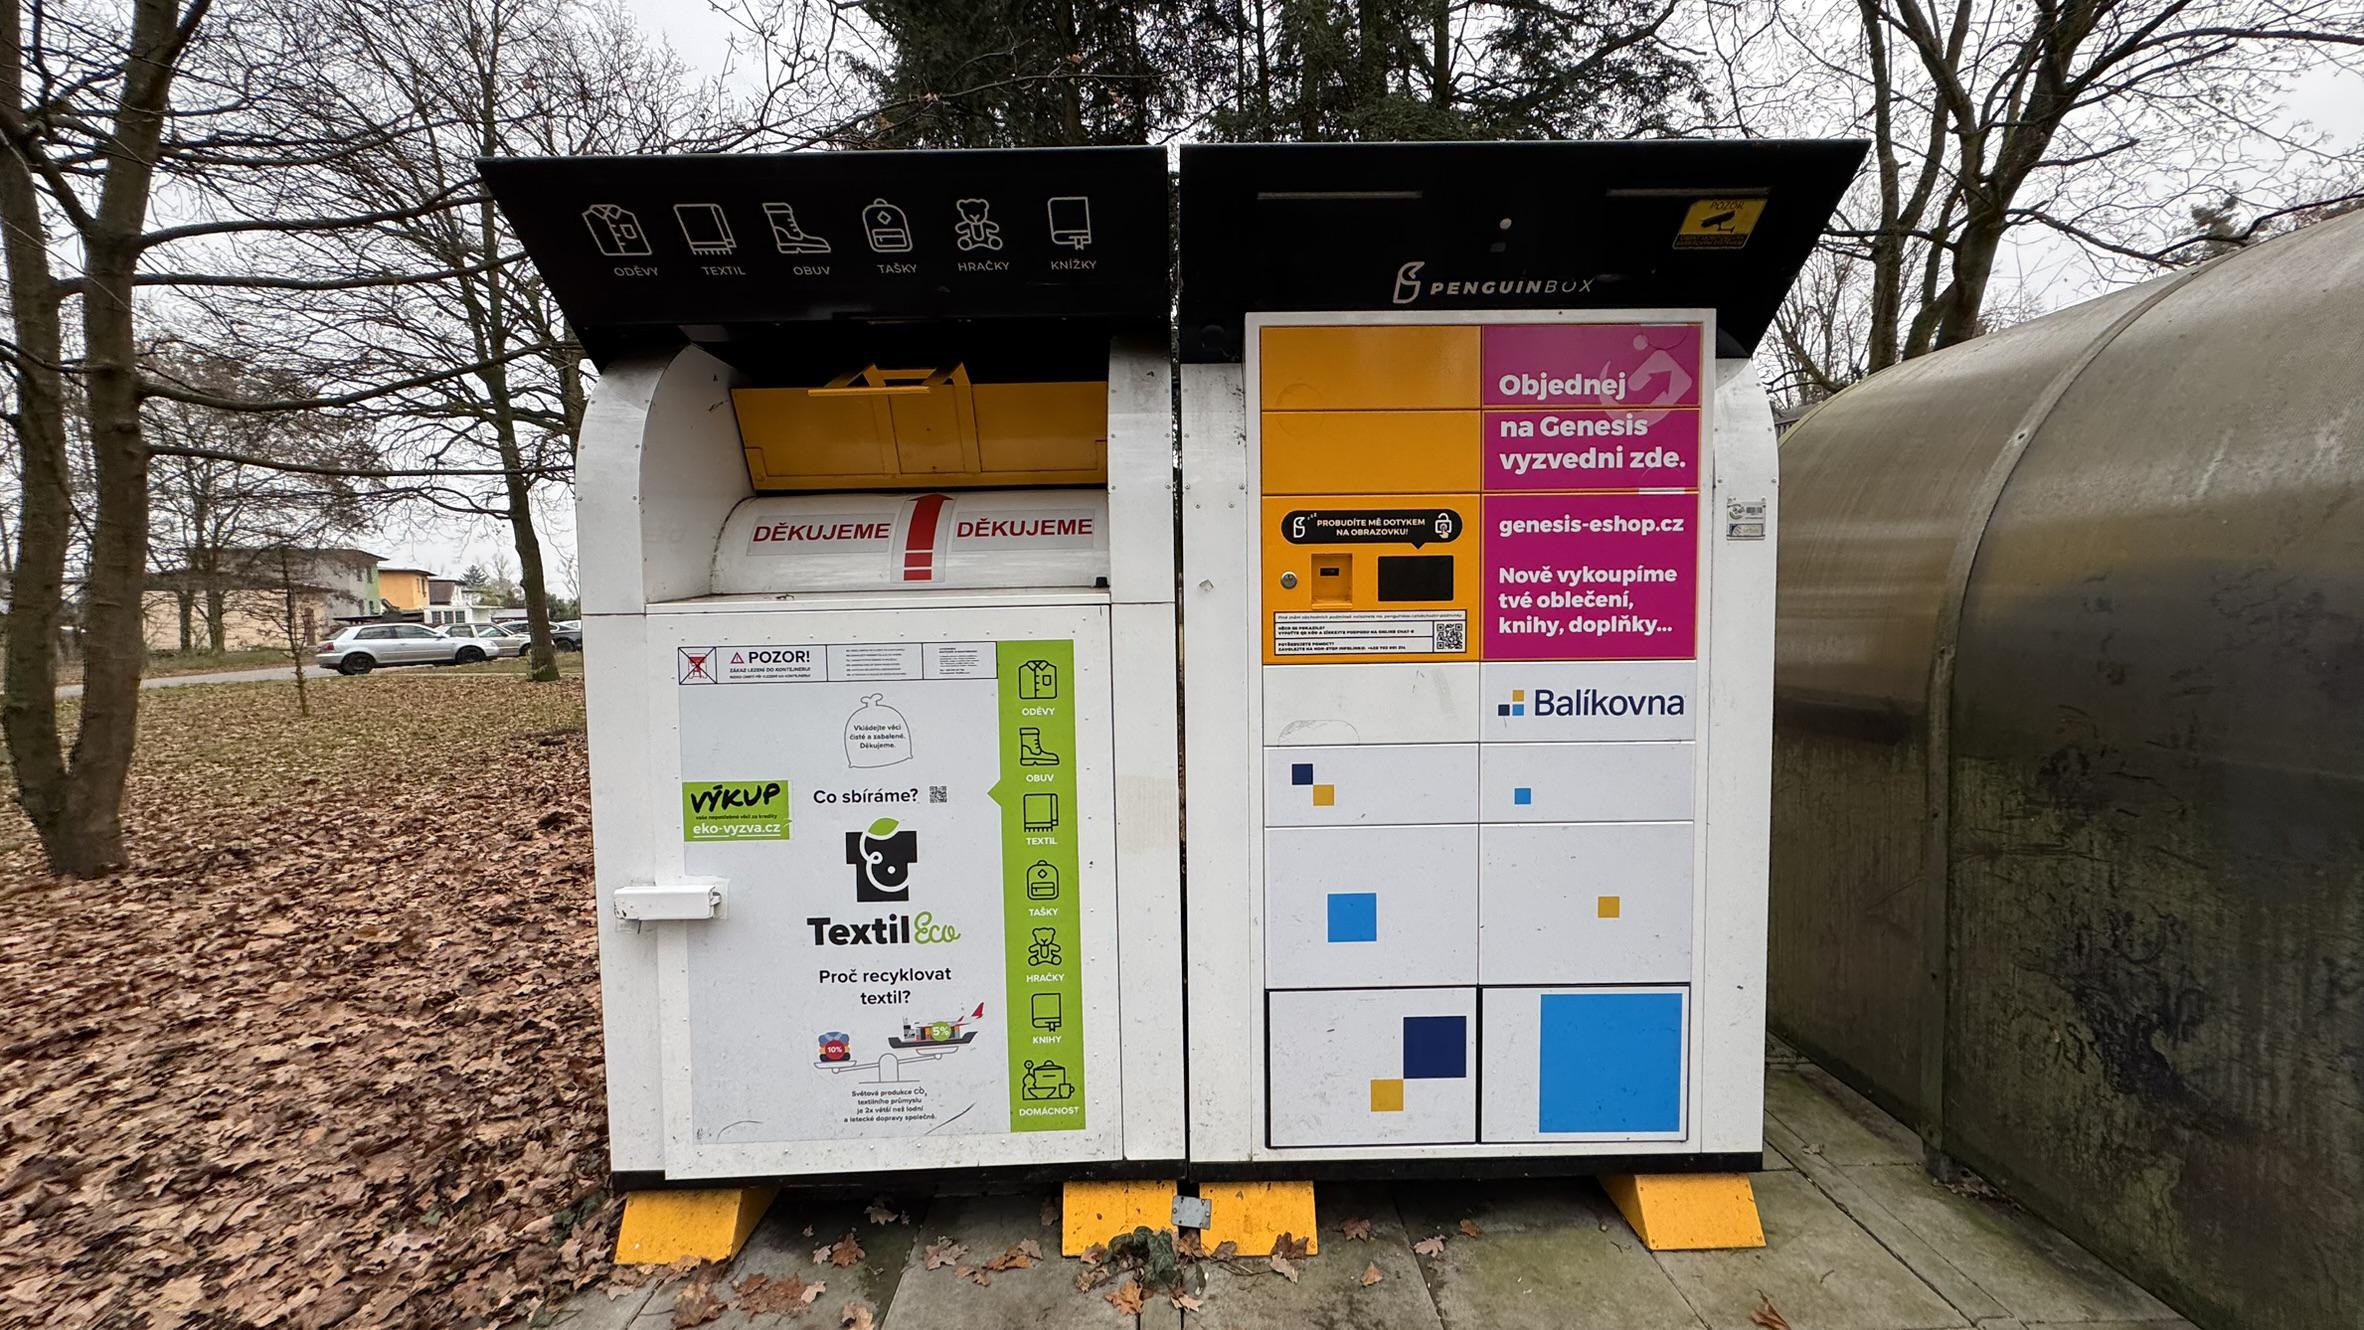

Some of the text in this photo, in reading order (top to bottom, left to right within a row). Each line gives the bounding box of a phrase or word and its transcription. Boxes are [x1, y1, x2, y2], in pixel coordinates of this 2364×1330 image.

[877, 262, 917, 274] TAŠKY
[958, 260, 1010, 272] HRAČKY
[1051, 258, 1097, 270] KNÍŽKY
[614, 266, 658, 276] ODĚVY
[701, 266, 746, 276] TEXTIL
[793, 266, 831, 276] OBUV
[1499, 372, 1626, 400] Objednej
[1500, 412, 1648, 437] na Genesis
[1500, 445, 1686, 475] vyzvedni zde.
[956, 516, 1094, 538] DĚKUJEME
[1317, 517, 1426, 527] PROBUDÍTE MĚ DOTYKEM
[1499, 514, 1684, 537] genesis-eshop.cz
[753, 520, 891, 542] DĚKUJEME
[1351, 528, 1408, 536] OBRAZOVKU!
[1499, 565, 1678, 586] Nově vykoupíme
[1499, 590, 1634, 610] tvé oblečení,
[1499, 615, 1672, 636] knihy, doplňky...
[748, 651, 810, 663] POZOR!
[1534, 689, 1684, 716] Balíkovna
[1022, 708, 1055, 716] ODĚVY
[1026, 774, 1054, 782] OBUV
[691, 783, 780, 813] VÝKUP
[813, 788, 918, 804] Co sbíráme?
[693, 823, 780, 836] eko-vyzva.cz
[1026, 837, 1056, 846] TEXTIL
[1028, 907, 1058, 916] TAŠKY
[807, 911, 961, 945] Textil Eco
[819, 968, 952, 985] Proč recyklovat
[1026, 973, 1064, 983] HRAČKY
[860, 990, 911, 1004] textil?
[932, 1026, 950, 1037] 5%
[1032, 1036, 1062, 1044] KNIHY
[880, 1089, 912, 1097] produkce
[890, 1097, 922, 1105] průmyslu
[1019, 1106, 1079, 1117] DOMÁCNOST
